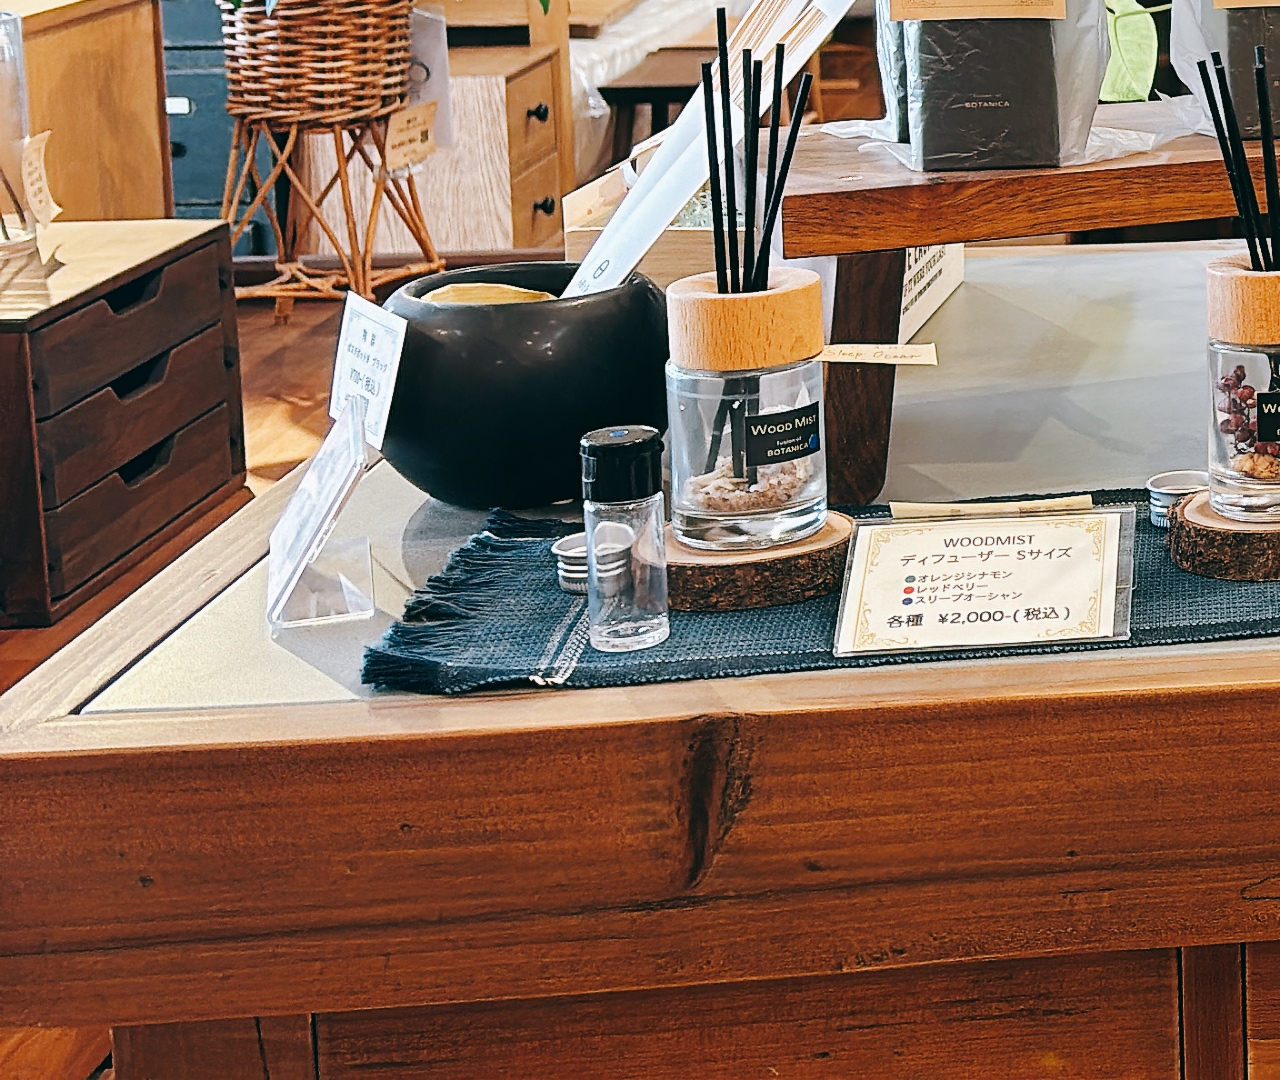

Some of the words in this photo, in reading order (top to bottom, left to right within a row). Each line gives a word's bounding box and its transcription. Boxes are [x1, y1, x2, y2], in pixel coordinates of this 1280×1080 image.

[767, 442, 808, 457] BOTANICA
[943, 534, 1035, 549] WOODMIST
[900, 550, 1009, 567] ディフューザー
[1017, 546, 1072, 561] Sサイズ
[917, 570, 1013, 583] オレンジシナモン
[916, 581, 988, 594] レッドベリー
[915, 591, 1024, 605] スリープオーシャン
[887, 613, 924, 628] 各種
